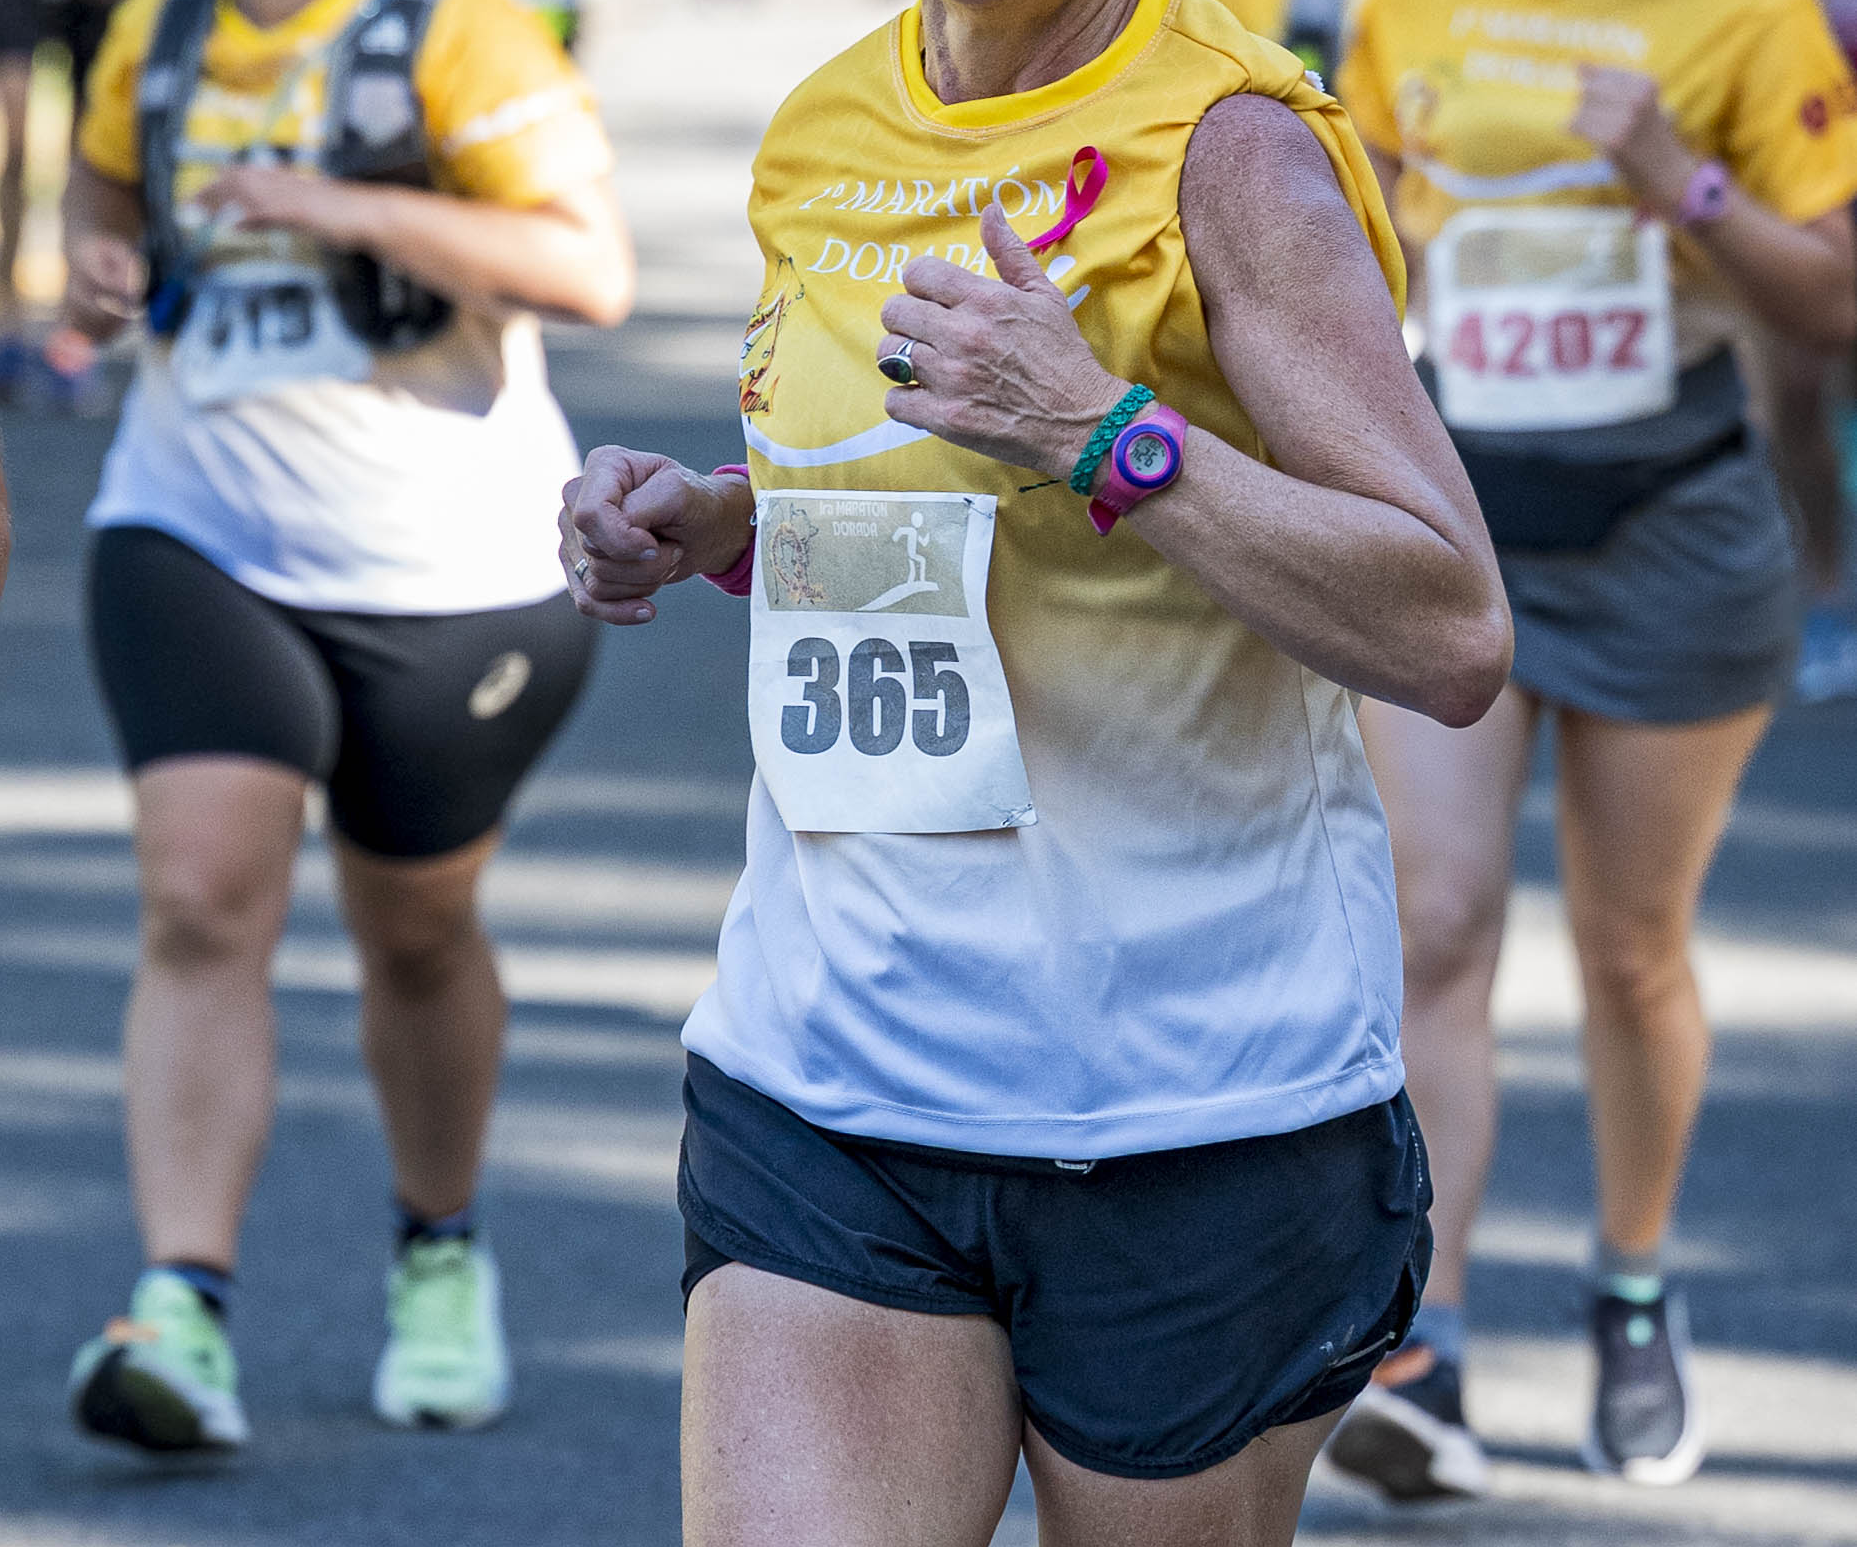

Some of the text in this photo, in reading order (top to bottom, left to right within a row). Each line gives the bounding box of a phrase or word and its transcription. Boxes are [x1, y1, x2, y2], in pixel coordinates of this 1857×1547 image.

[1448, 306, 1650, 377] 4202
[832, 521, 879, 537] DORADA
[780, 636, 971, 757] 365
